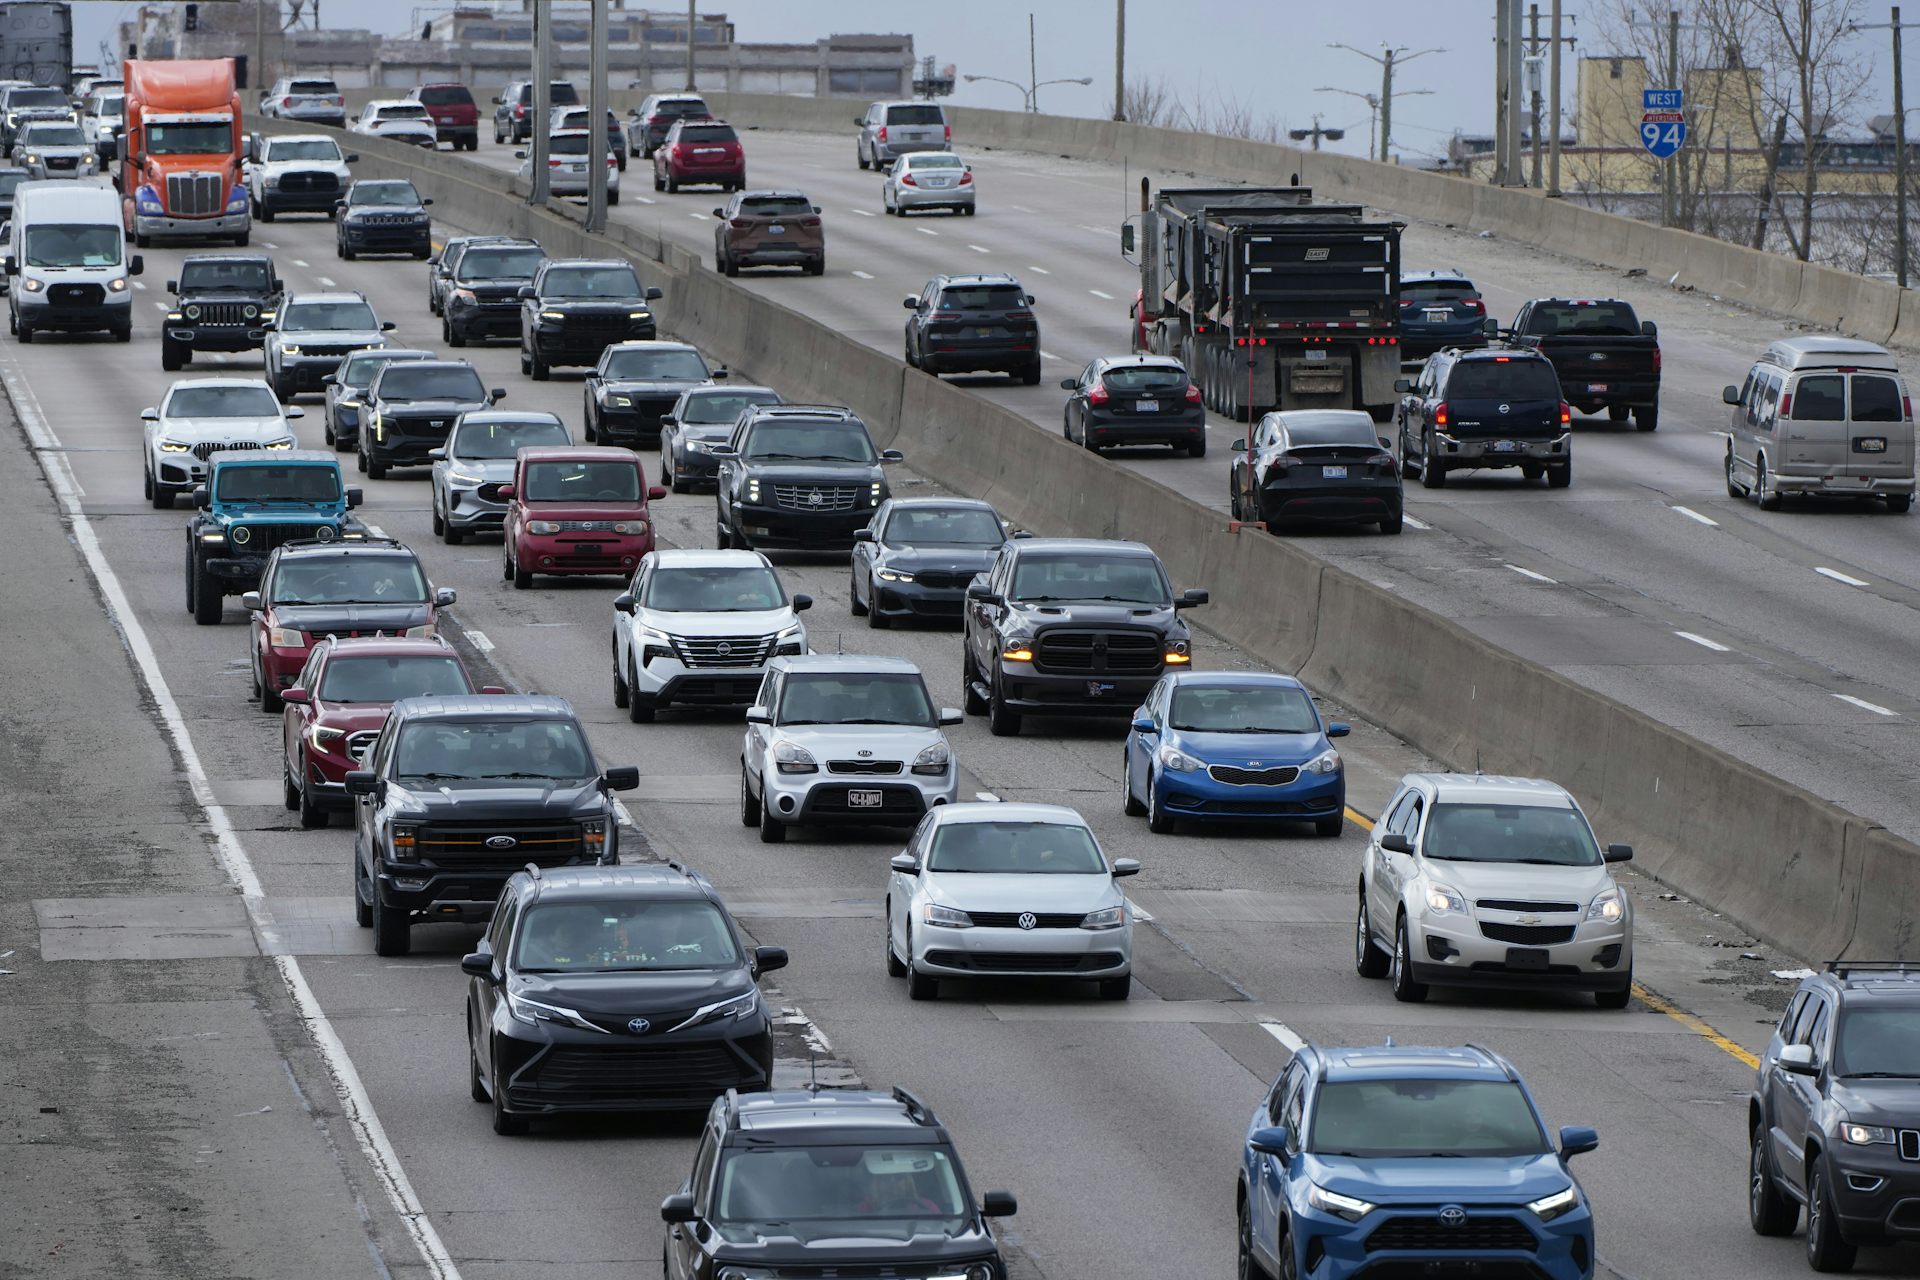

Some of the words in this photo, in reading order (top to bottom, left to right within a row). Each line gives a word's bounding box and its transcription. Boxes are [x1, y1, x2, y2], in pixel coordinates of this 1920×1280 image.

[1648, 93, 1677, 105] WEST
[1647, 114, 1679, 122] INTERSTATE
[1643, 123, 1680, 149] 94
